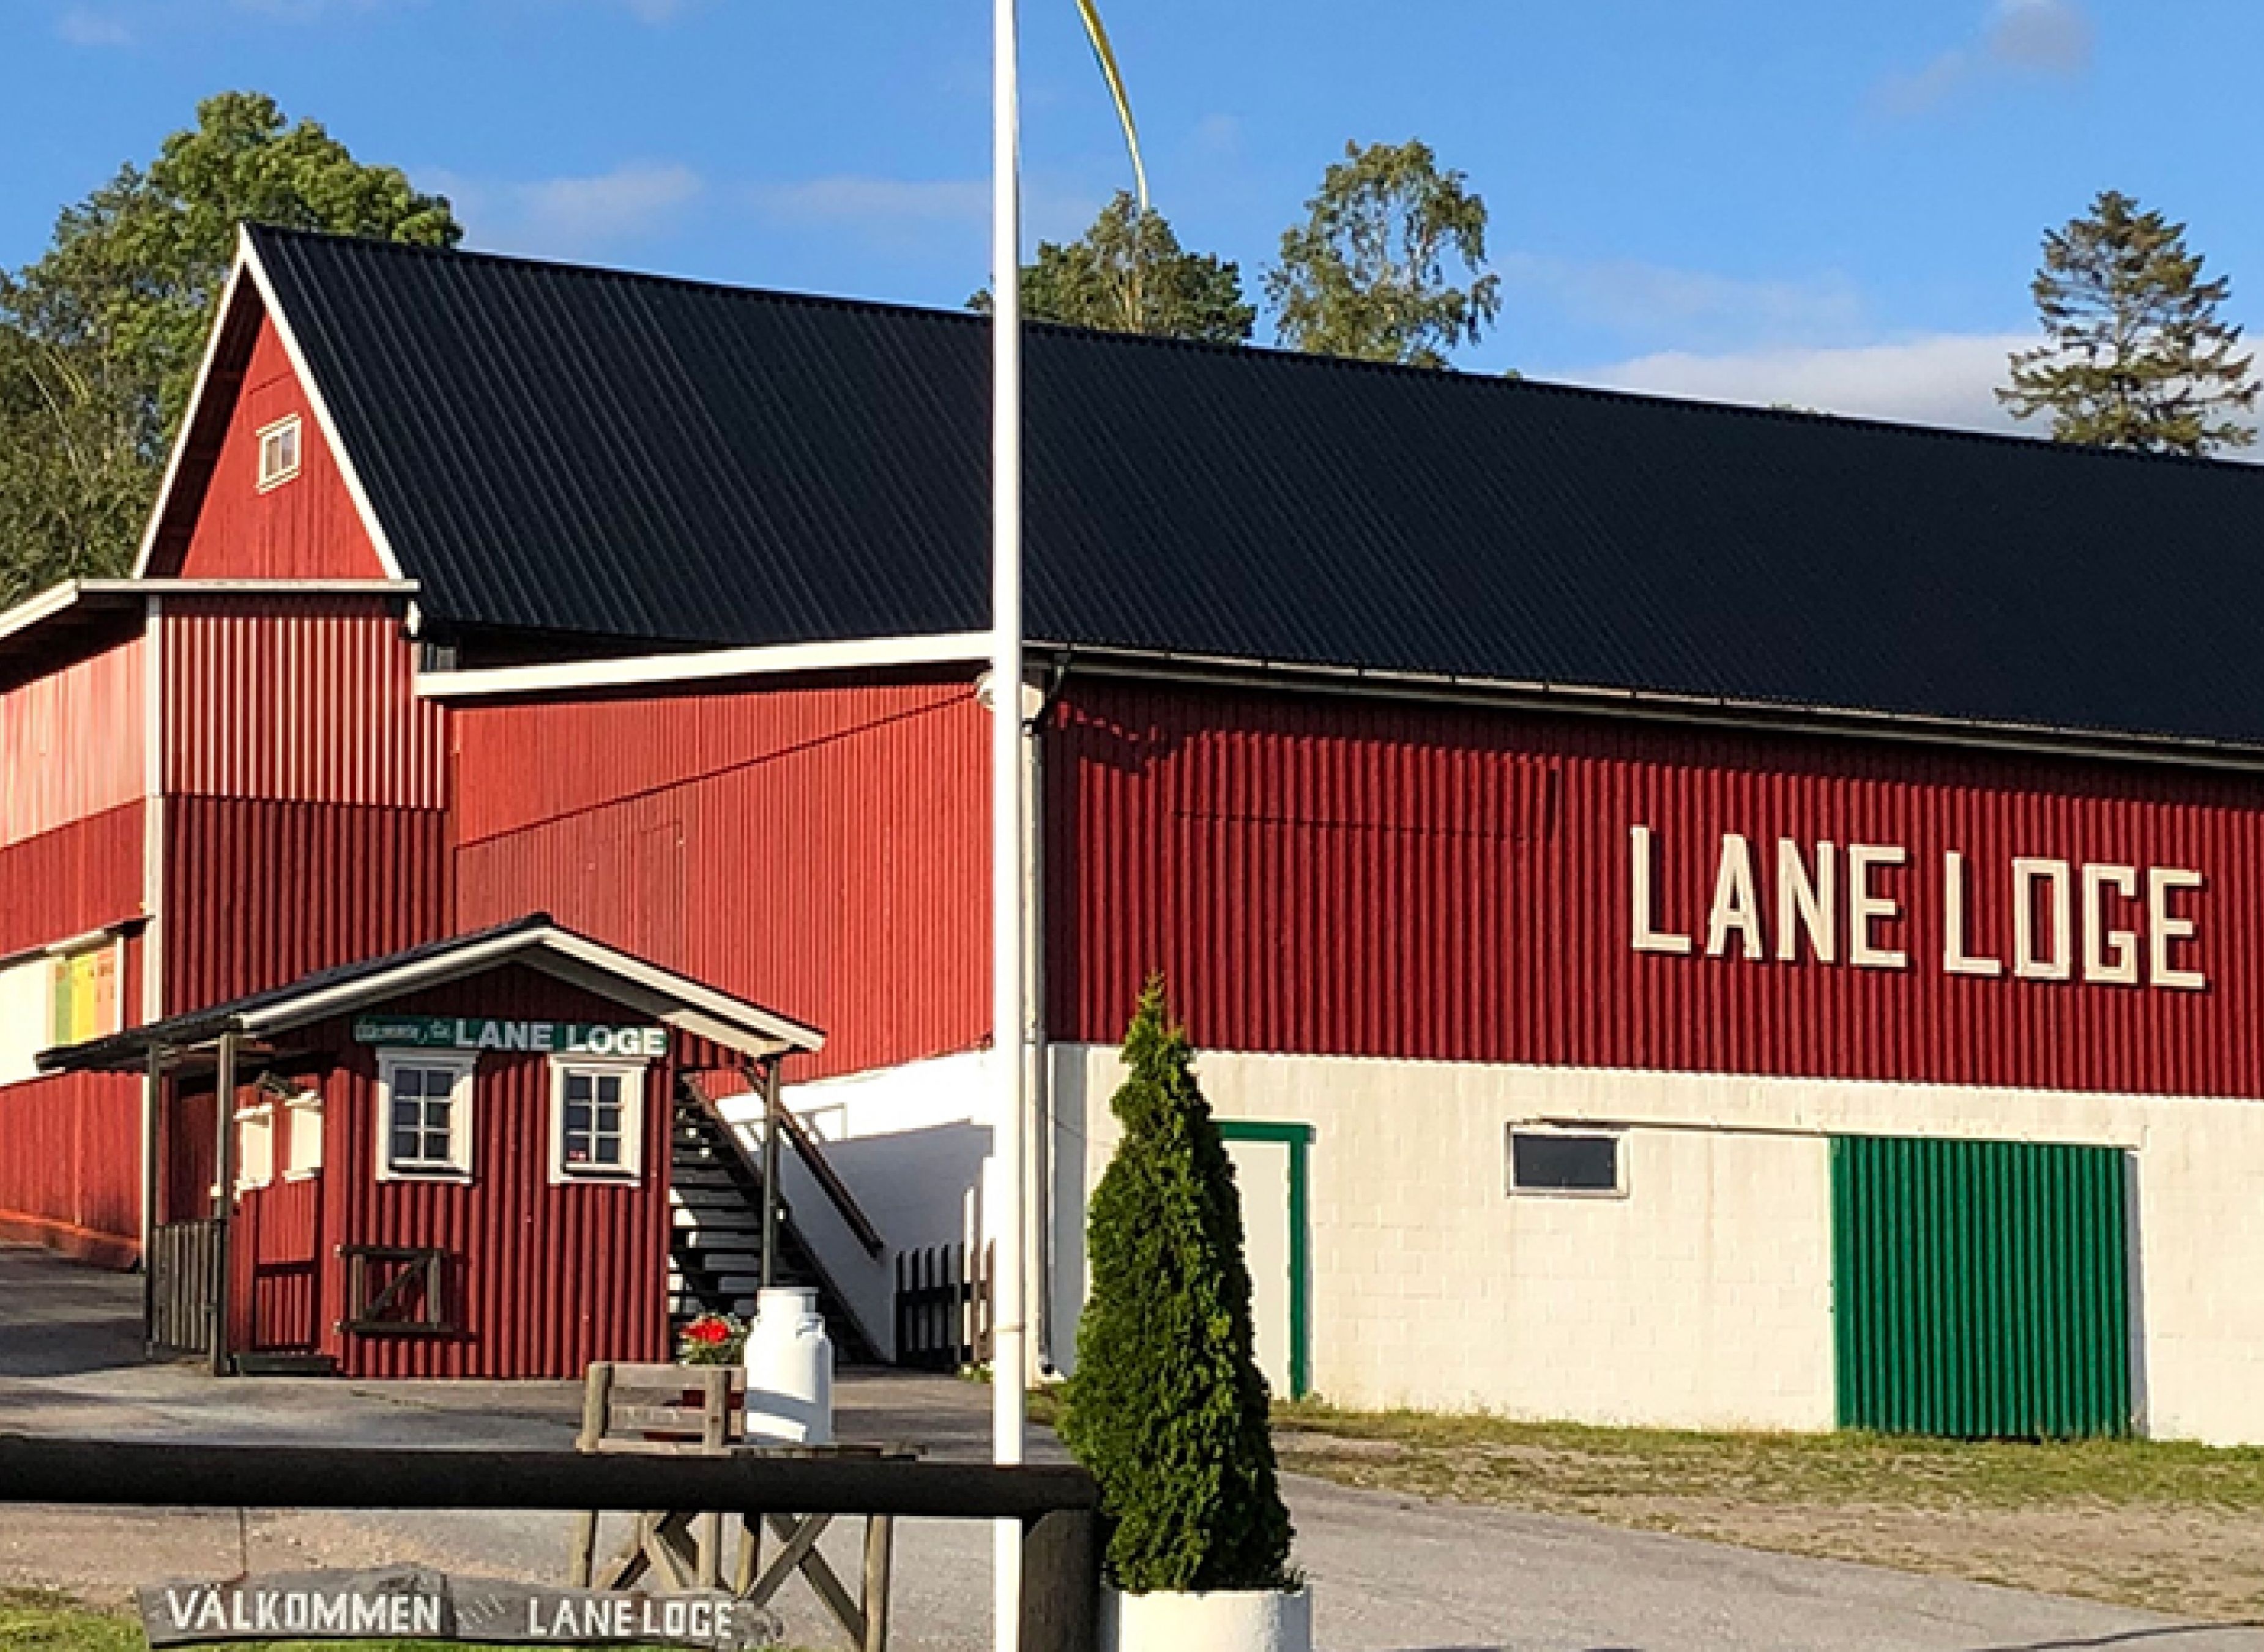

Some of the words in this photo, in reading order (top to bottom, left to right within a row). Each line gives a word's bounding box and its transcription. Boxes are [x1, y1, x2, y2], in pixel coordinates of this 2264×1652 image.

[1630, 824, 1907, 968] LANE
[1943, 850, 2205, 988] LOGE
[455, 1018, 554, 1052] LANE
[565, 1024, 667, 1054] LOGE
[168, 1583, 438, 1632] VÄLKOMMEN
[529, 1597, 632, 1636] LANE
[642, 1599, 734, 1639] LOGE
